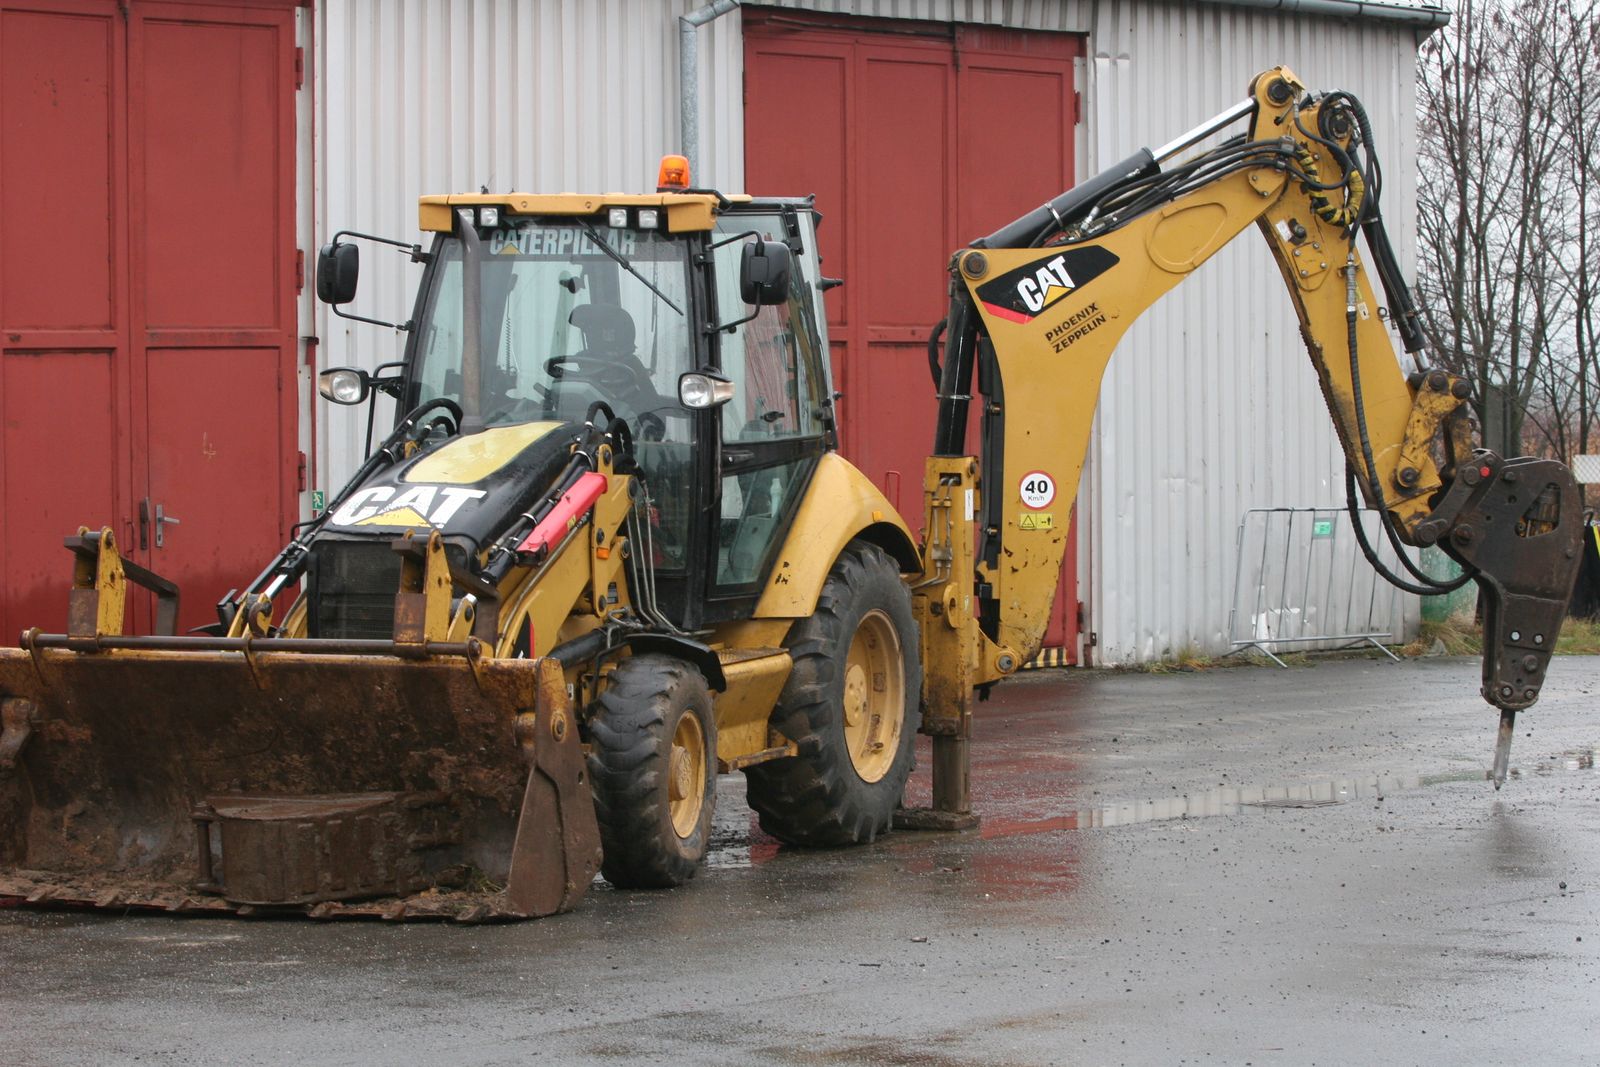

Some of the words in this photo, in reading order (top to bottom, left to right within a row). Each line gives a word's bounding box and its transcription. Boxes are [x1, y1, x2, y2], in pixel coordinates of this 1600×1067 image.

[489, 228, 635, 255] CATERPILLAR
[1017, 255, 1076, 312] CAT
[1045, 302, 1098, 341] PHOENIX
[1053, 314, 1107, 354] ZEPPELIN
[1025, 480, 1048, 494] 40
[331, 486, 487, 529] CAT
